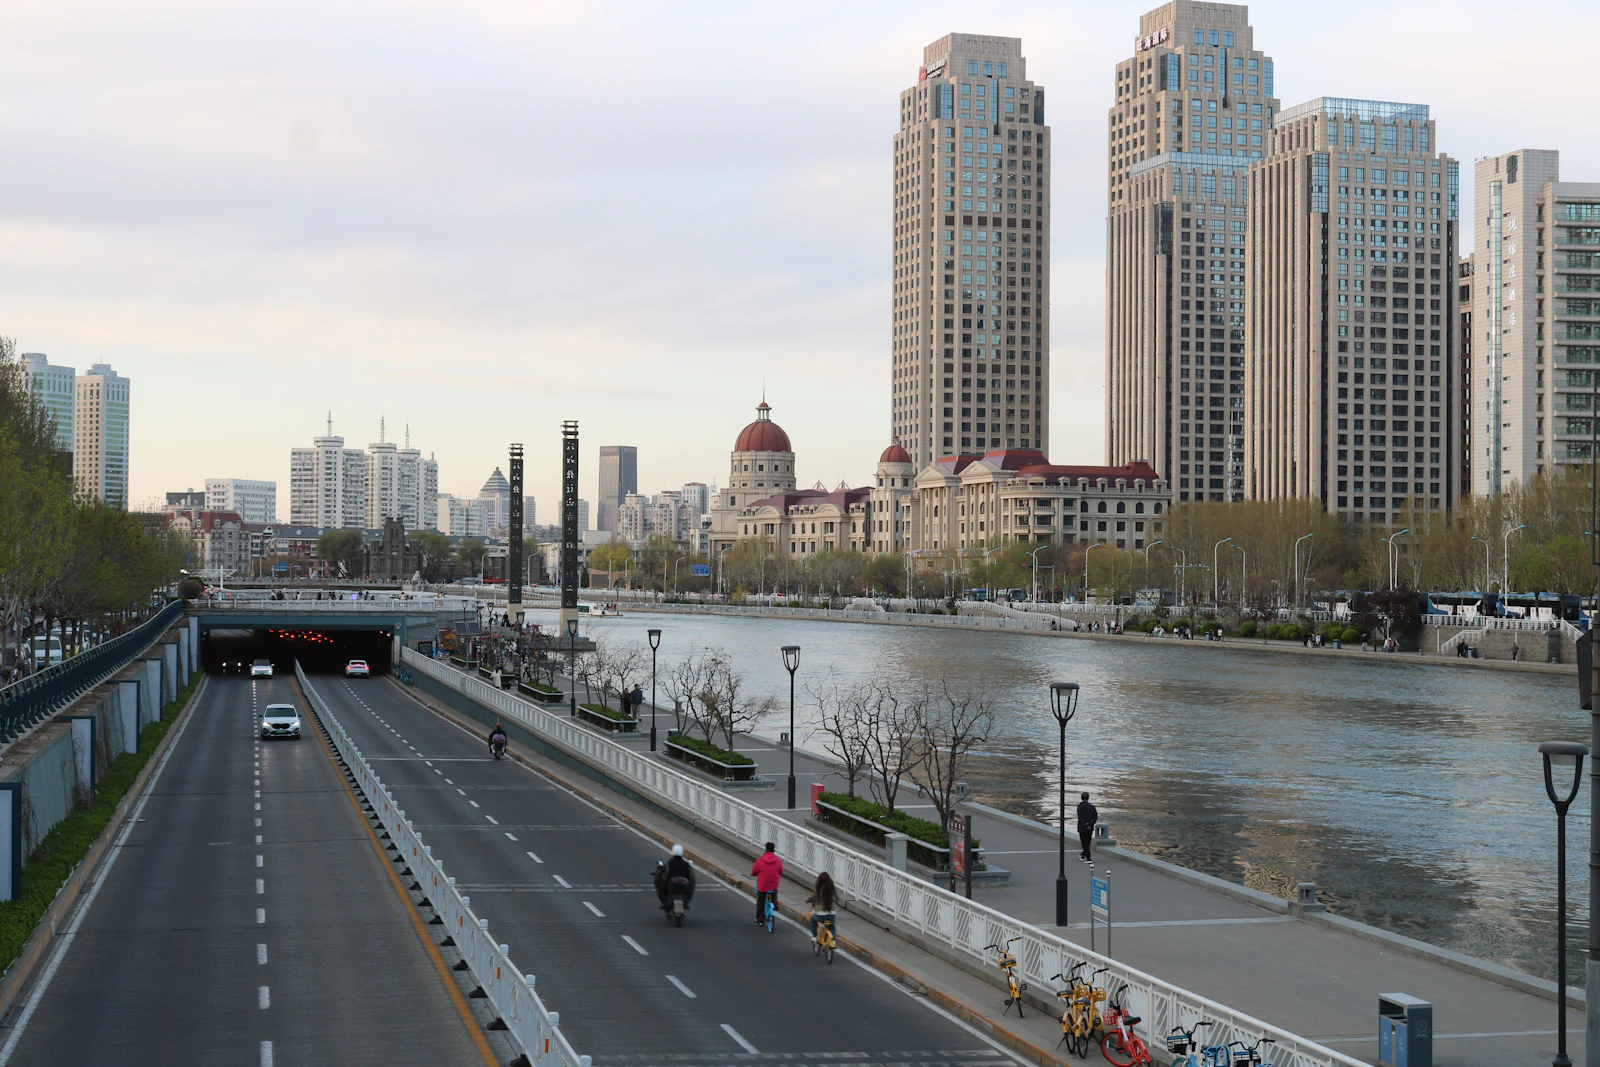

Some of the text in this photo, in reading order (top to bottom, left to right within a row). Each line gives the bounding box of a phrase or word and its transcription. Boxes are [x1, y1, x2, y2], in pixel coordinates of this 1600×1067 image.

[1507, 217, 1517, 326] 悦榕庄酒店
